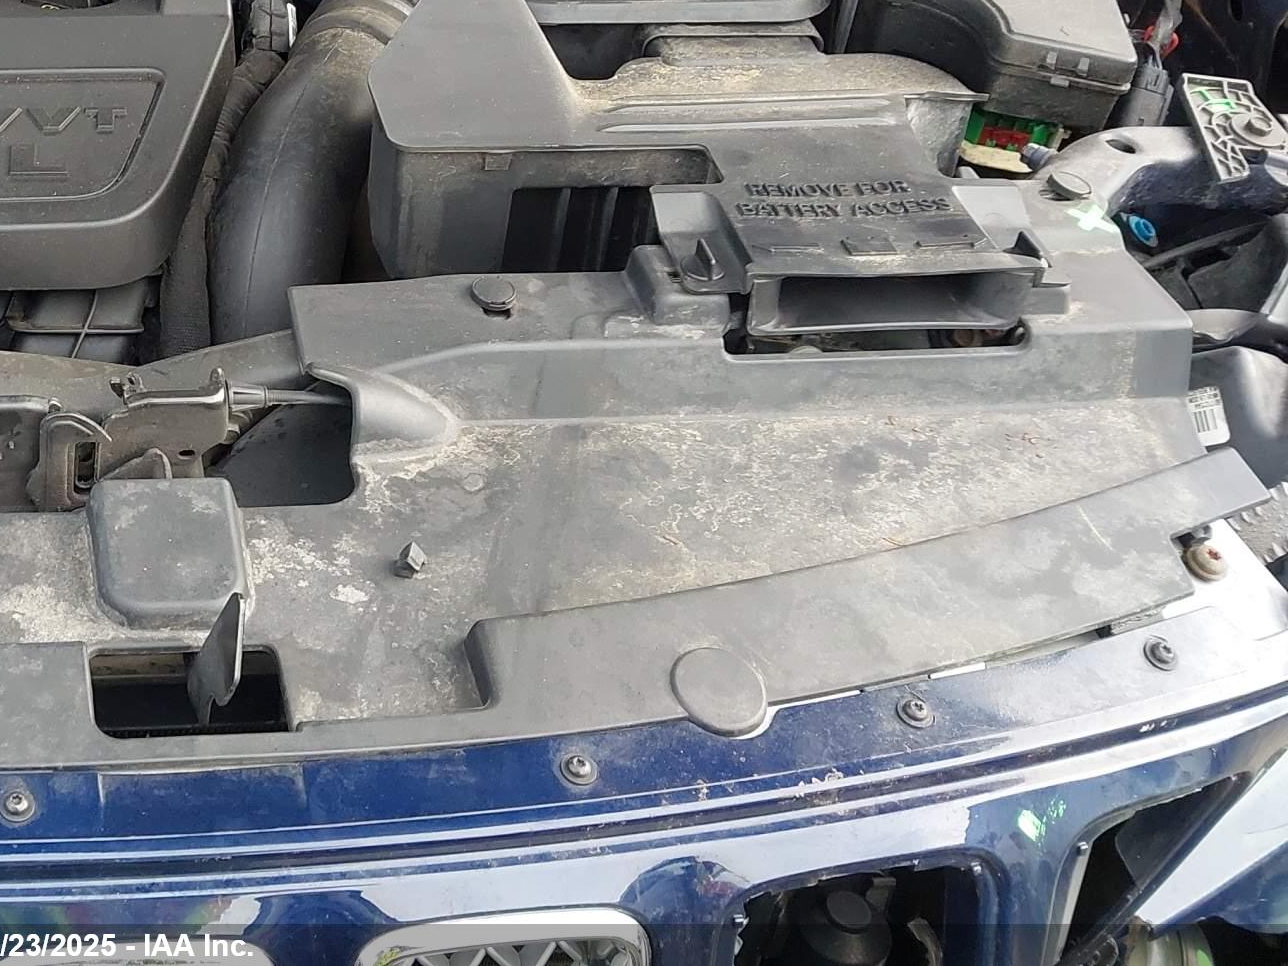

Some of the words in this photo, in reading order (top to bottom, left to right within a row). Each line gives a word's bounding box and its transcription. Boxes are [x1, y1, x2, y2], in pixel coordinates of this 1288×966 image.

[745, 182, 849, 197] REMOVE
[857, 180, 912, 196] FOR
[736, 201, 842, 217] BATTERY
[851, 198, 953, 217] ACCESS
